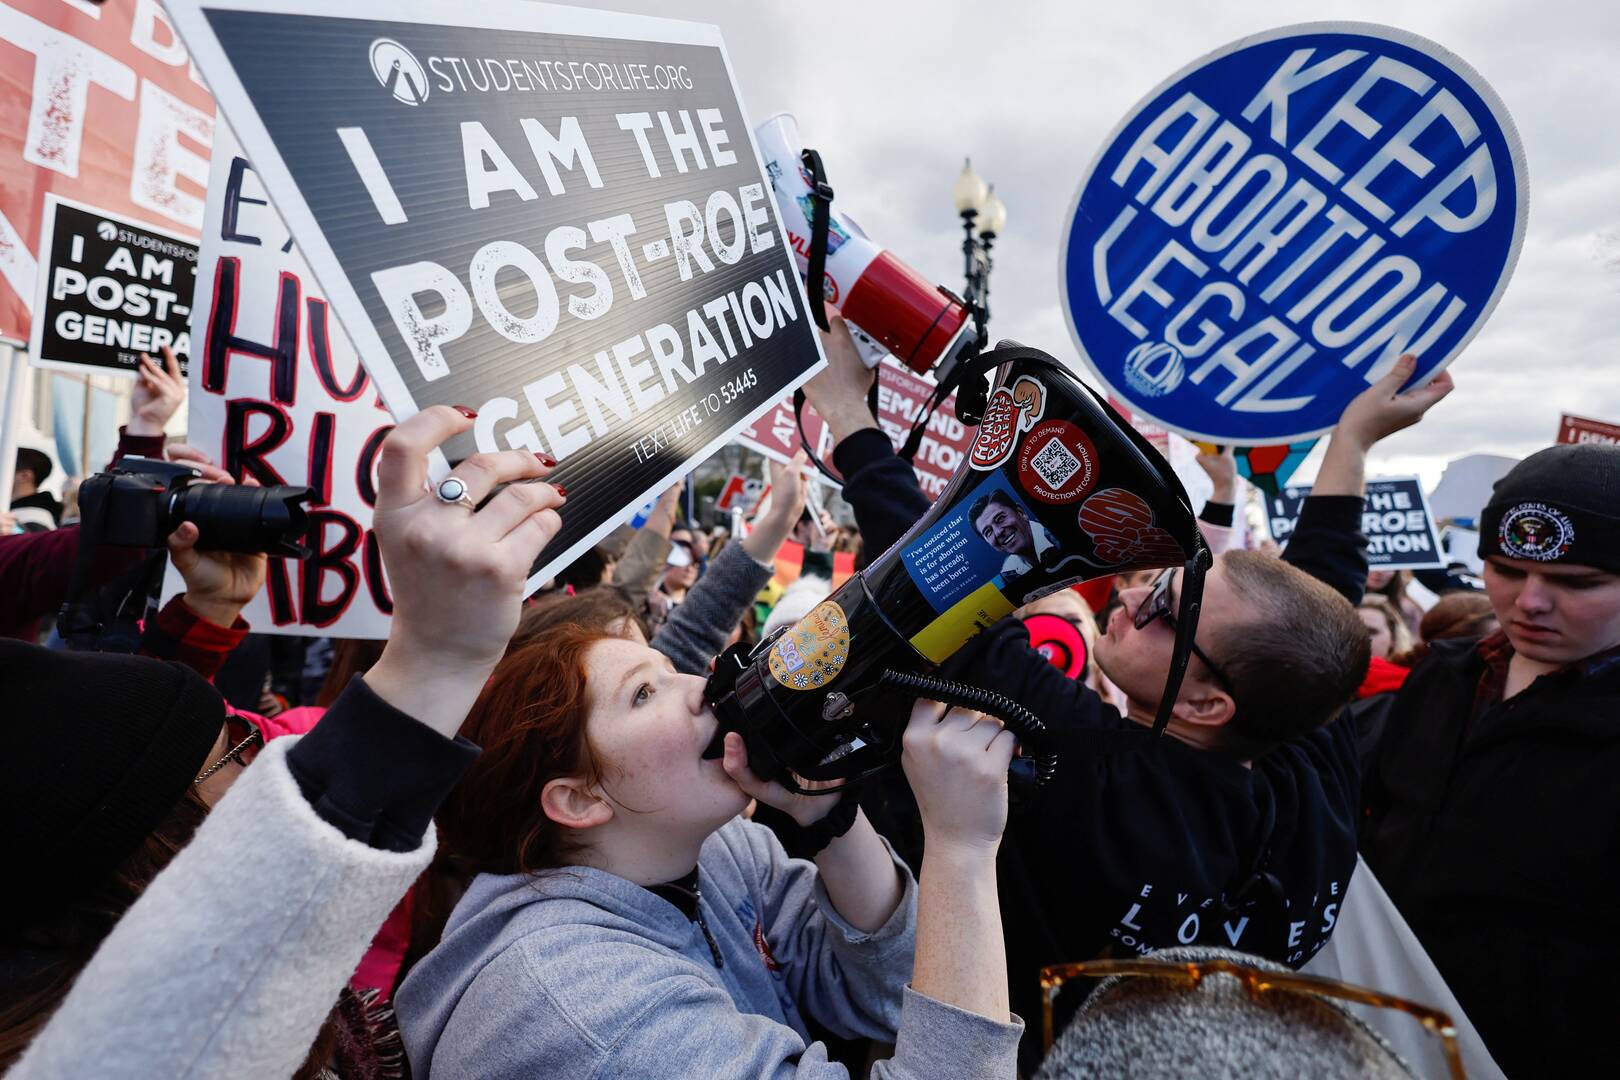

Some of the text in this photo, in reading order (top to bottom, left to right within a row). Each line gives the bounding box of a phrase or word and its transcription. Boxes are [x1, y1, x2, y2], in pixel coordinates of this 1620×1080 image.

[428, 56, 693, 94] STUDENTSFORLIFE.ORG
[336, 107, 738, 225] I AM THE
[1241, 47, 1498, 238] KEEP
[71, 234, 174, 286] I AM
[1111, 91, 1467, 388] ABORTION
[53, 266, 191, 326] POST-
[370, 183, 775, 382] POST-ROE
[1093, 204, 1317, 413] LEGAL
[55, 311, 191, 355] GENERA
[473, 270, 798, 462] GENERATION
[630, 368, 758, 464] TEXT LIFE TO 53445
[878, 384, 965, 441] EMAND
[1024, 445, 1031, 455] US
[1029, 435, 1038, 444] TO
[1037, 427, 1065, 438] DEMAND
[1033, 442, 1092, 500] PROTECTION AT CONCEPTION
[914, 529, 961, 567] everyone who
[920, 537, 968, 575] is for abortion
[923, 527, 949, 549] noticed
[948, 515, 963, 530] that
[925, 552, 965, 585] has already
[931, 579, 950, 594] been
[1120, 902, 1337, 948] LOVES
